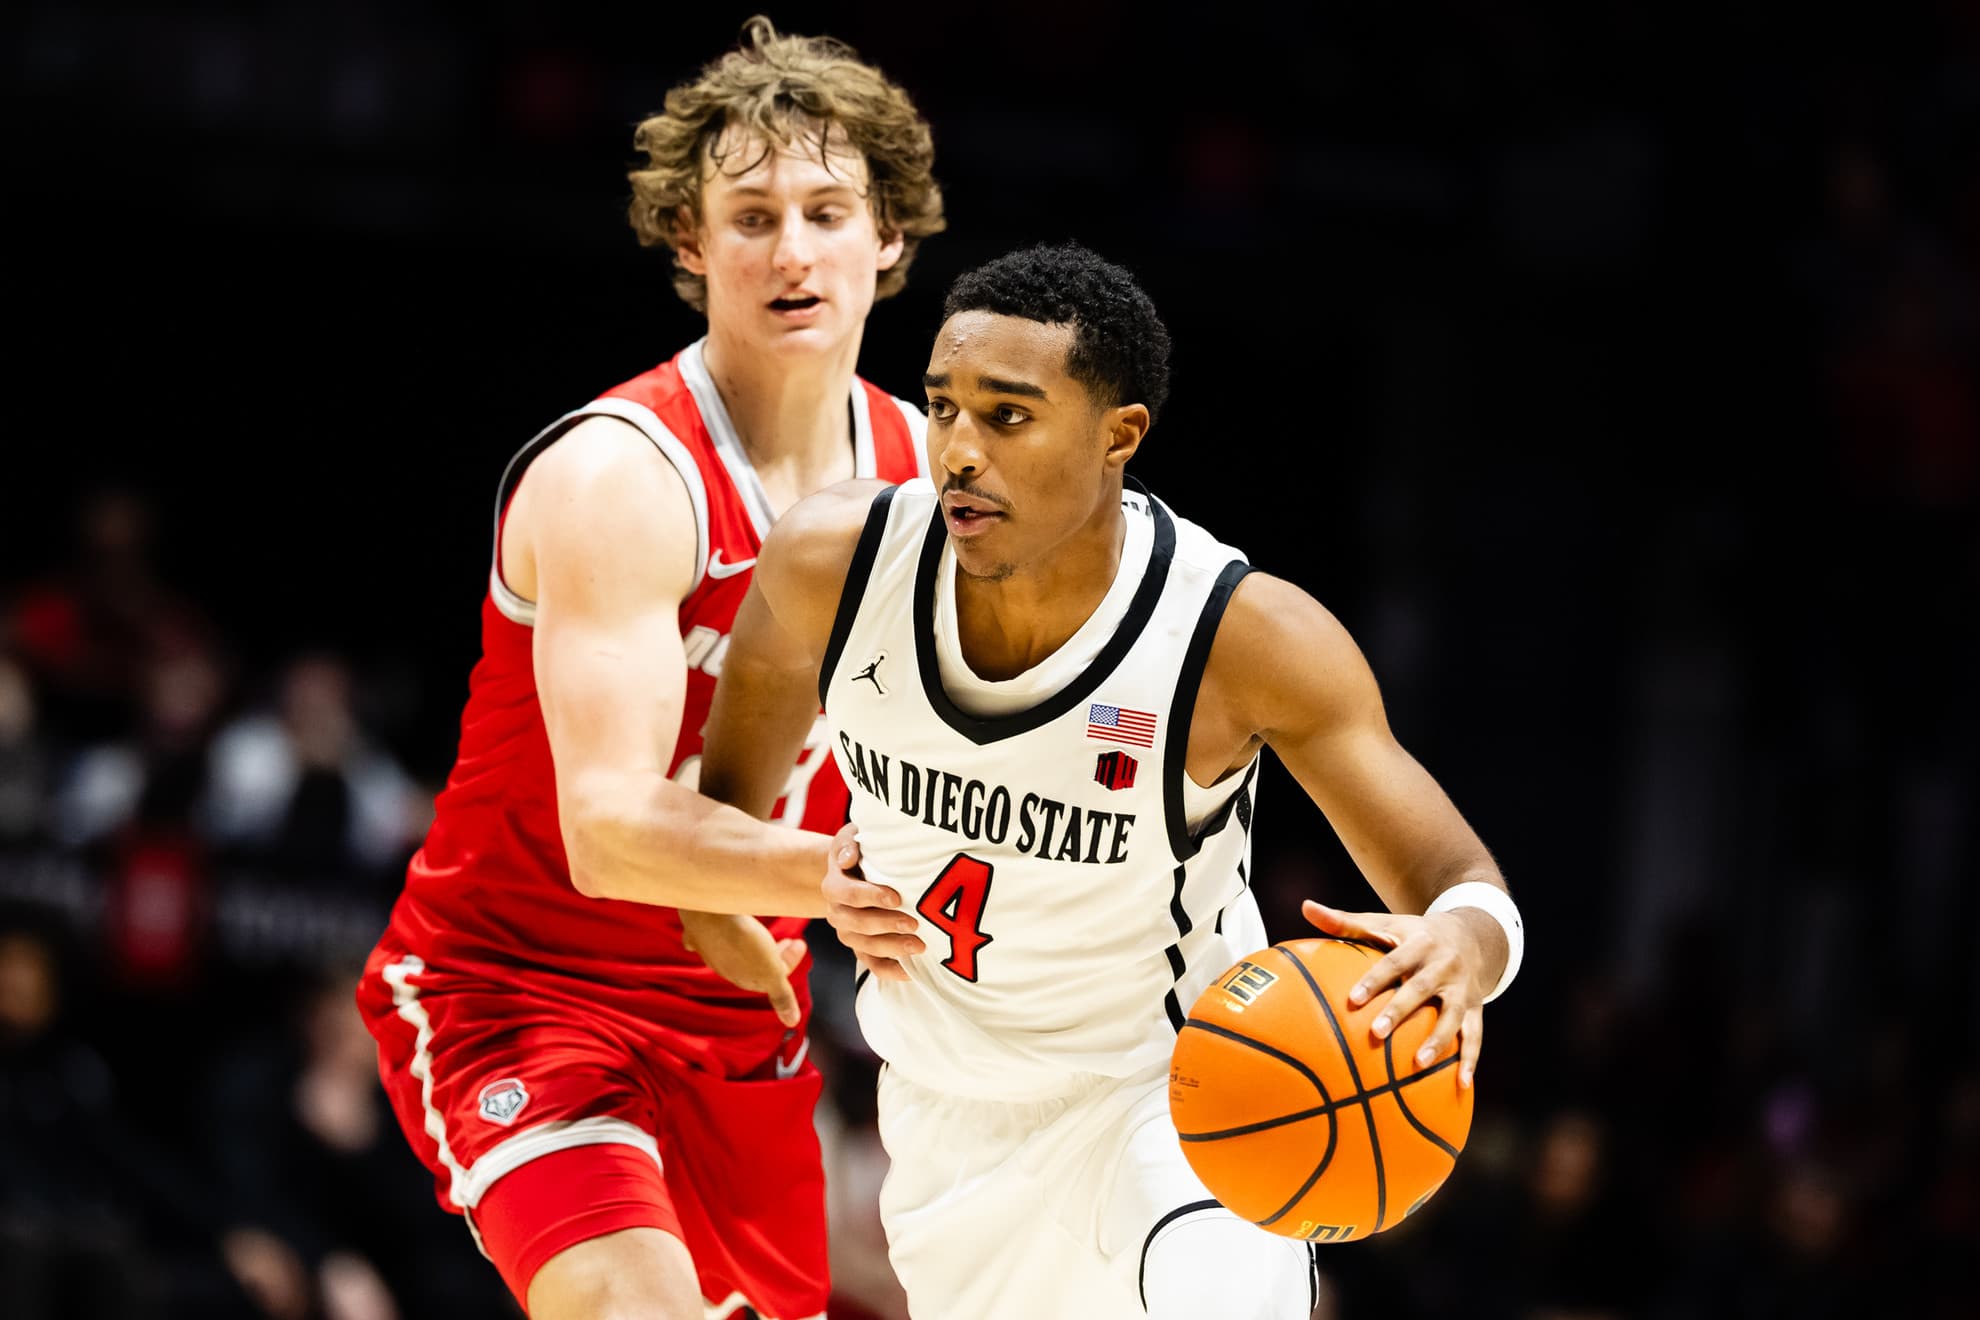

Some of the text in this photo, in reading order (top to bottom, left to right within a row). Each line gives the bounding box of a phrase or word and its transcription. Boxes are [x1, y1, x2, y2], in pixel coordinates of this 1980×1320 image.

[840, 730, 890, 807] SAN
[900, 760, 1011, 844] DIEGO
[1015, 792, 1136, 864] STATE
[916, 852, 994, 983] 4
